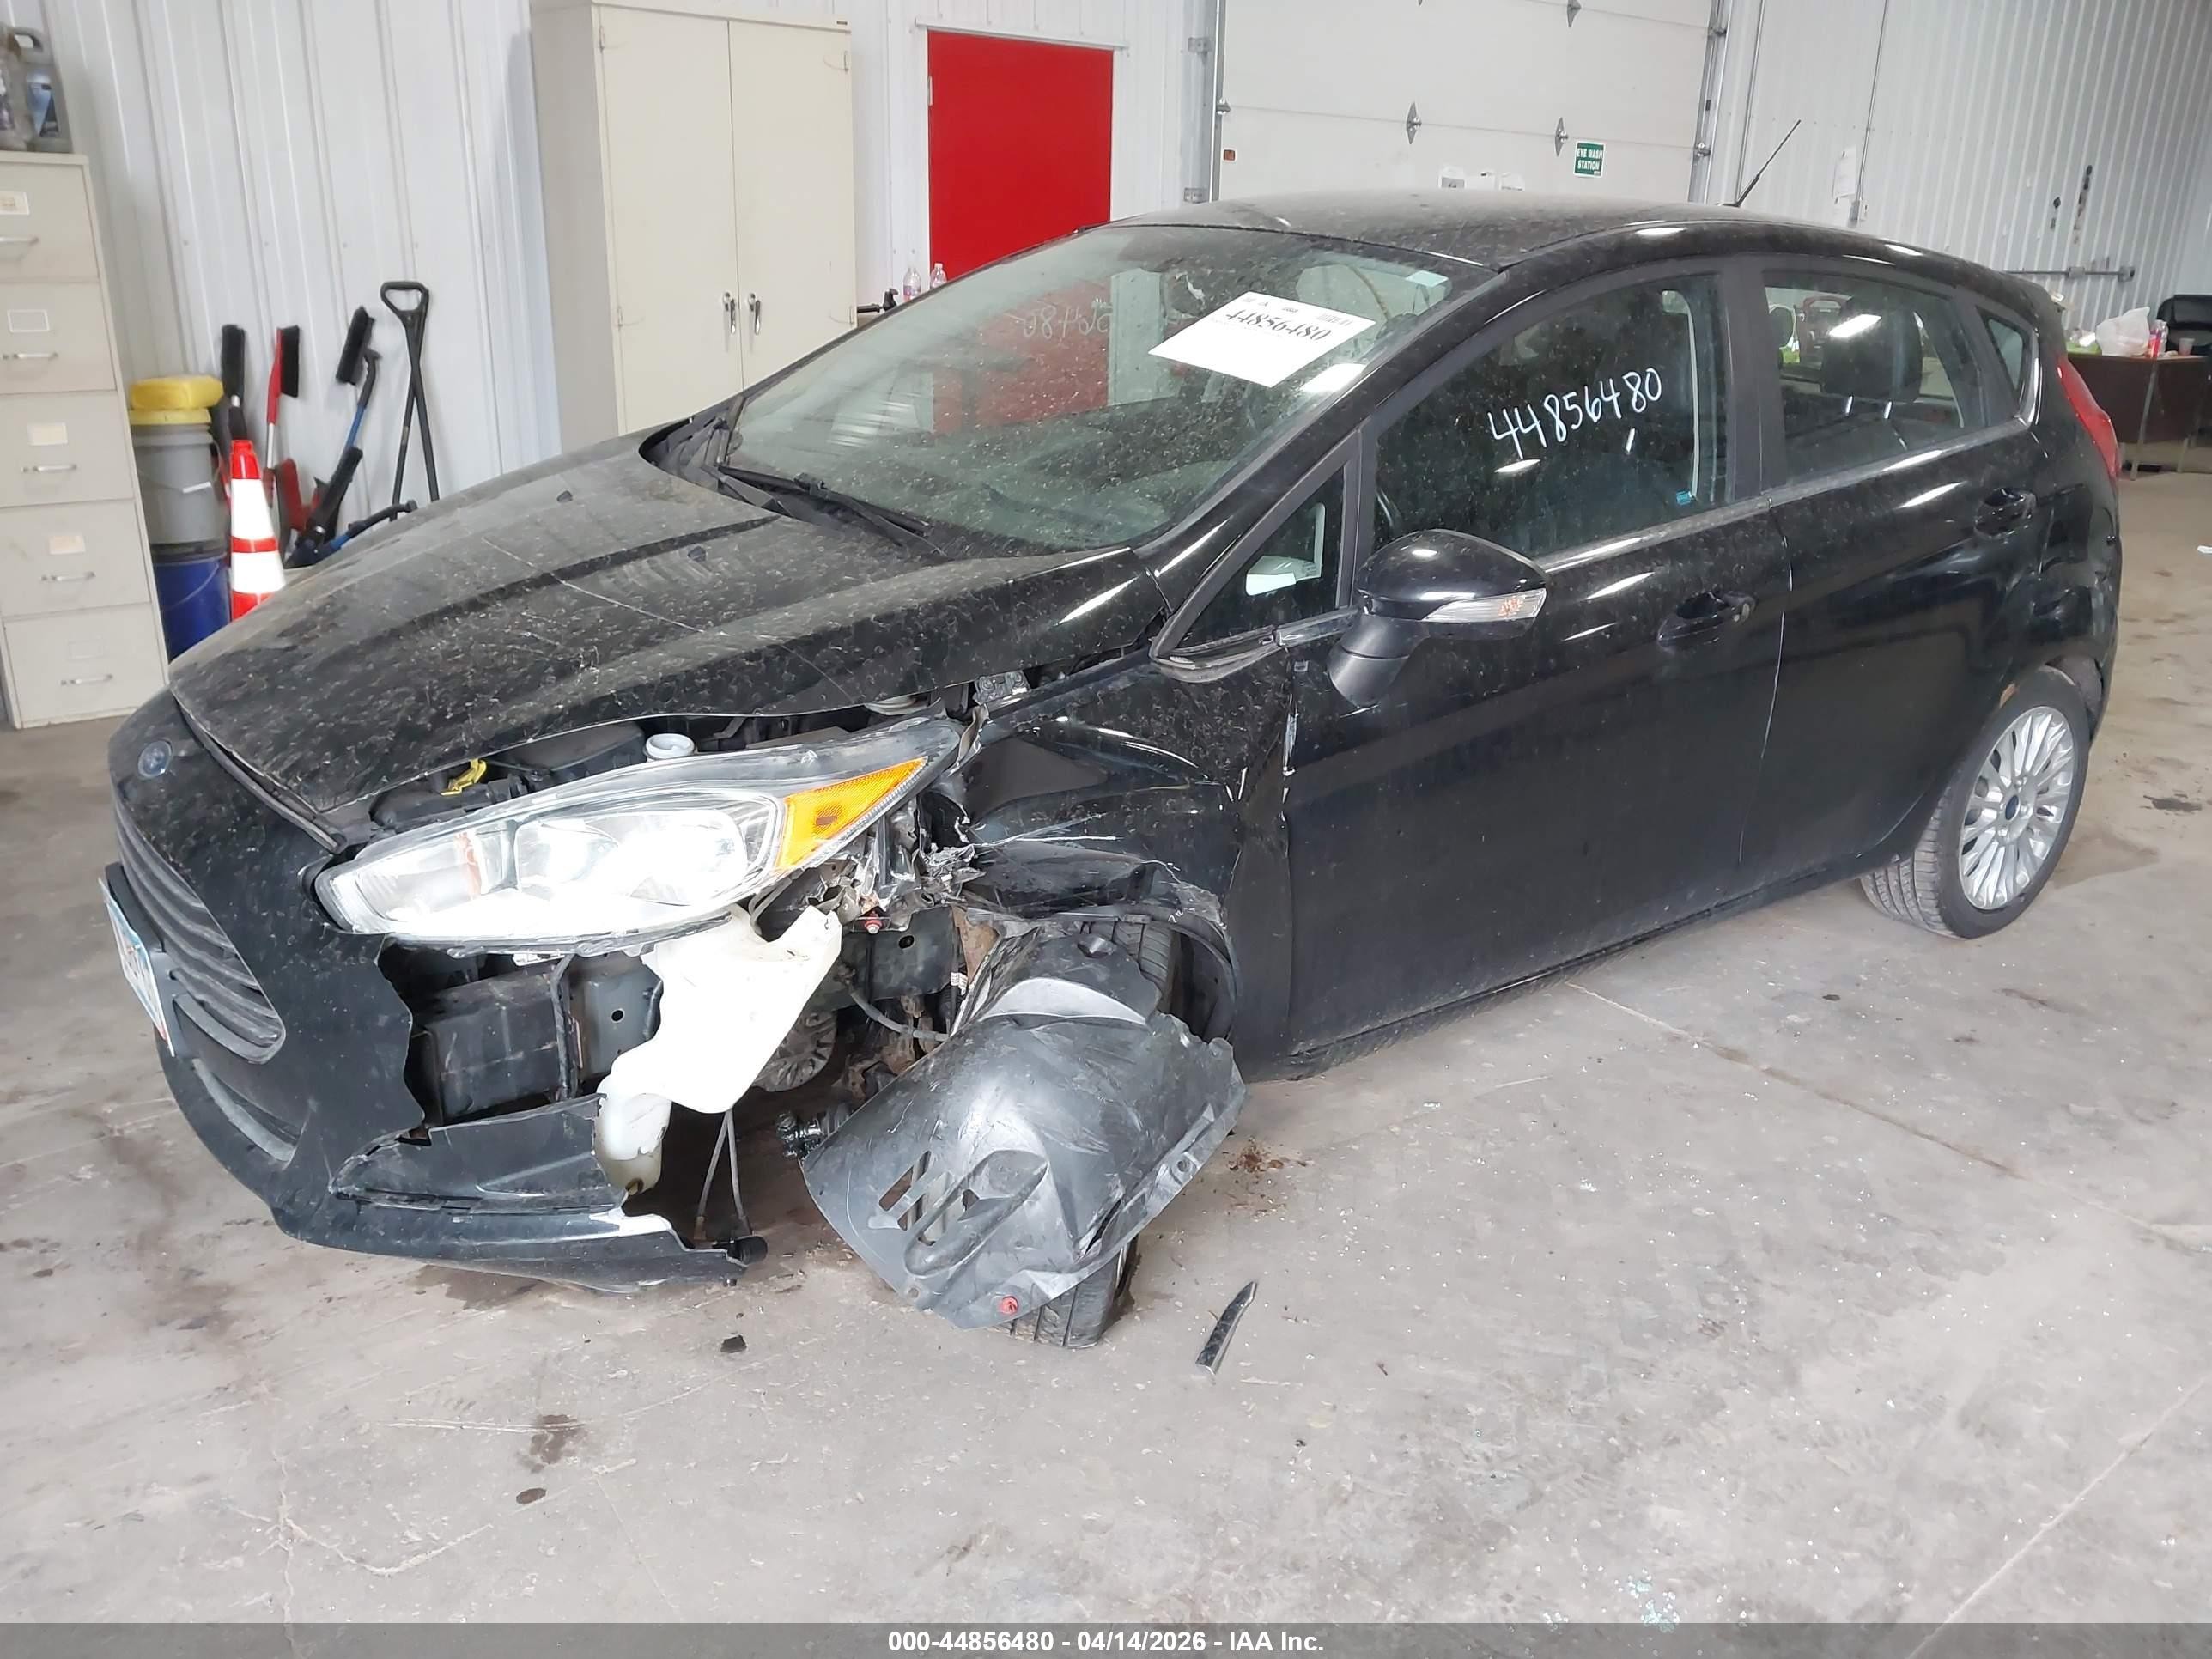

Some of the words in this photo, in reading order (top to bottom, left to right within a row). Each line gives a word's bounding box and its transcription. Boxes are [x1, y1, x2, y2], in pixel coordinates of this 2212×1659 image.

[1577, 148, 1588, 158] EYE
[1588, 149, 1603, 160] WASH
[1577, 160, 1600, 171] STATION
[1225, 309, 1332, 341] 44856480
[1487, 368, 1662, 460] 44856480
